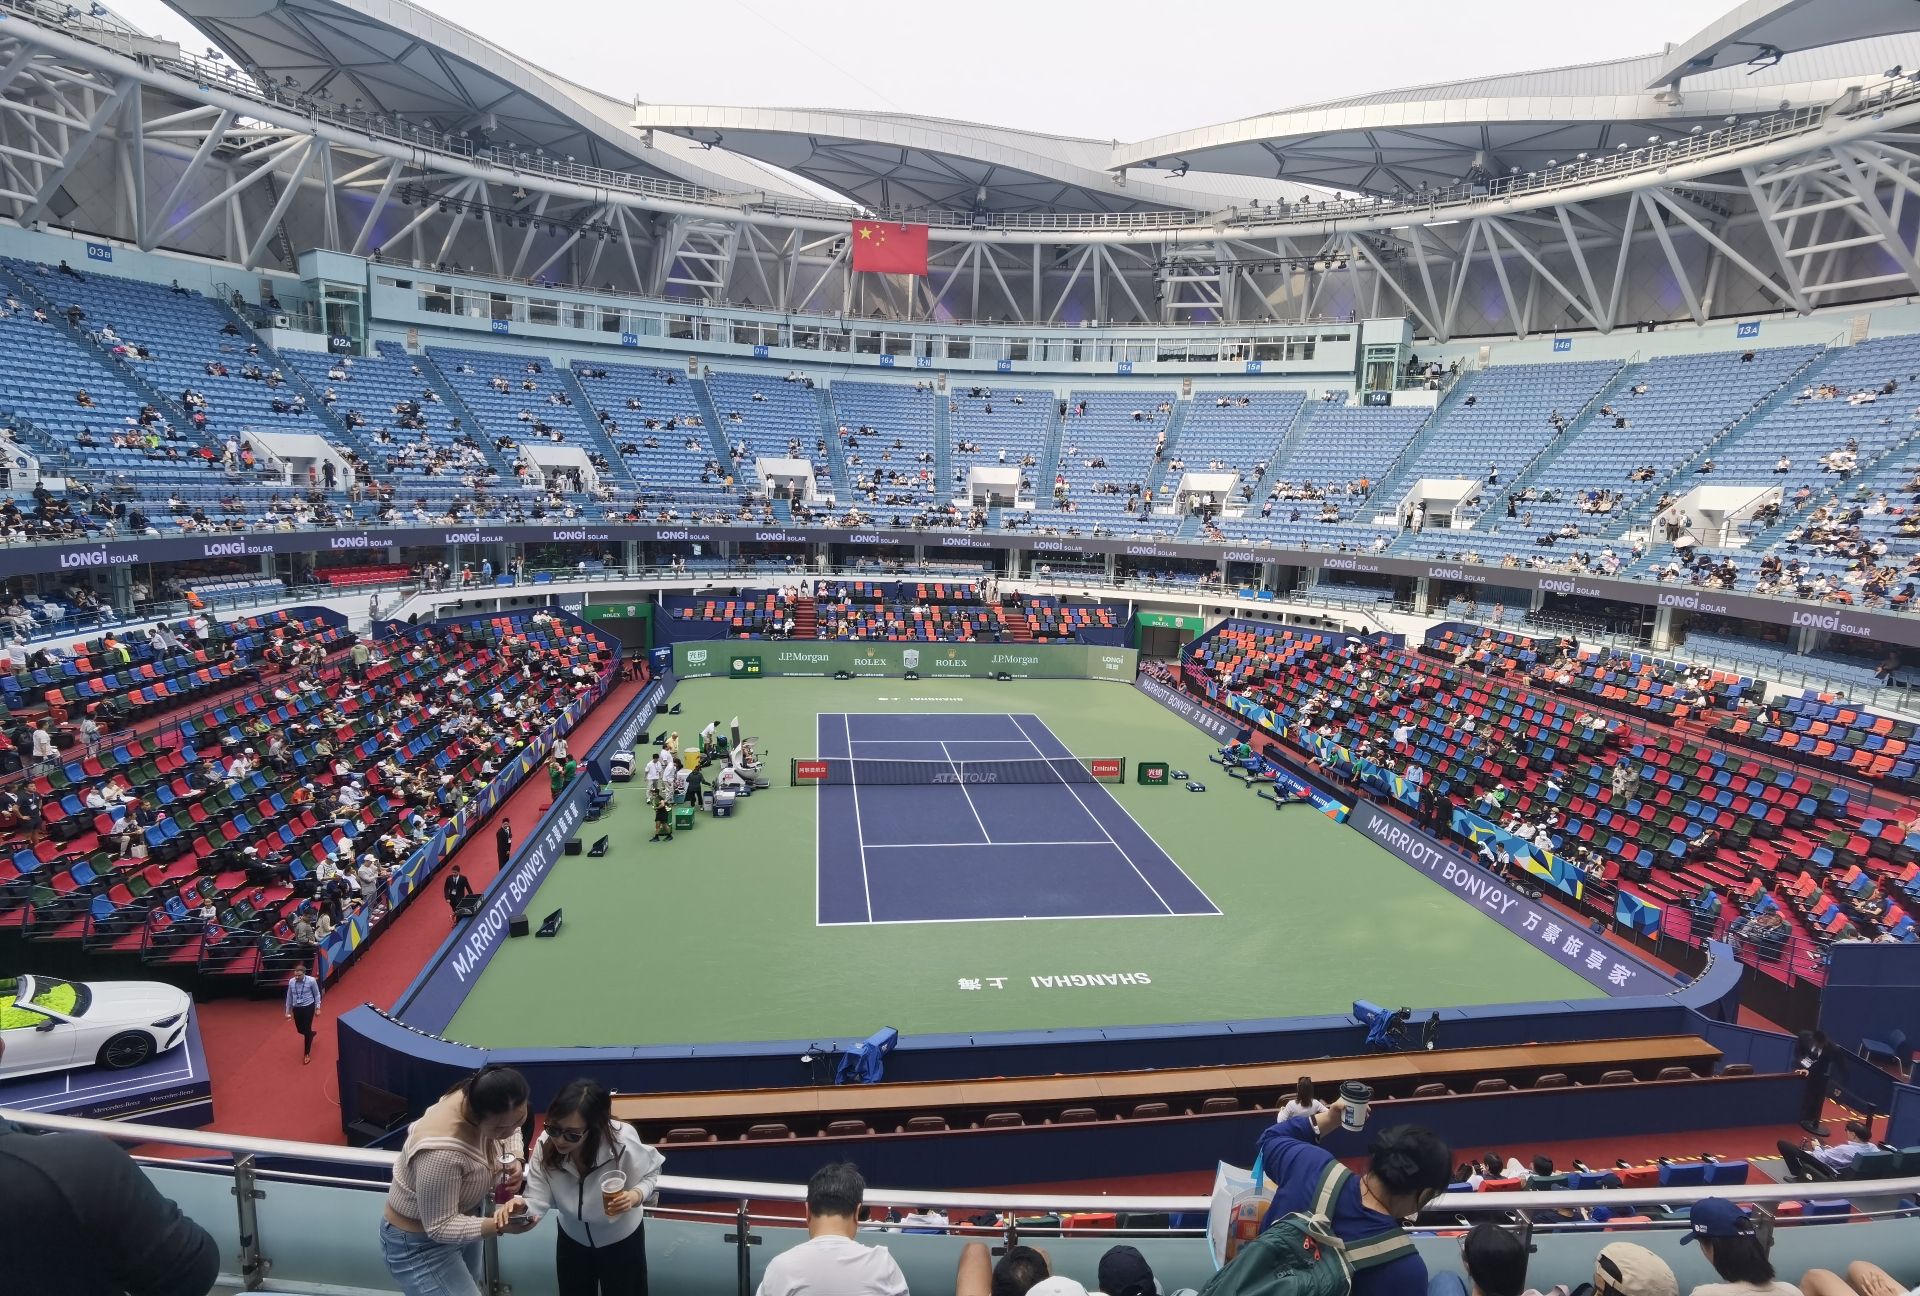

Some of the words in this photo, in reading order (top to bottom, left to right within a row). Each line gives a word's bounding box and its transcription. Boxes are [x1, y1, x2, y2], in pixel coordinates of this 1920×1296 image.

[89, 246, 110, 259] 03B
[492, 322, 508, 331] 02B
[1738, 326, 1758, 335] 13A
[333, 338, 351, 348] 02A
[623, 335, 637, 344] 01A
[1118, 364, 1132, 372] 15A
[1371, 394, 1386, 402] 14A
[370, 539, 393, 547] SOLAR
[248, 545, 273, 554] SOLAR
[110, 554, 138, 564] SOLAR
[1358, 564, 1379, 572] SOLAR
[1464, 574, 1486, 583] SOLAR
[1576, 587, 1600, 597] SOLAR
[1700, 602, 1726, 614] SOLAR
[1840, 623, 1870, 637] SOLAR
[778, 652, 829, 663] J.P.Morgan
[991, 655, 1038, 666] J.P.Morgan
[1142, 679, 1169, 701] MARRIOTT
[963, 773, 997, 782] TOUR
[1367, 814, 1443, 870] MARRIOTT
[1442, 861, 1516, 915] BONVOY
[452, 892, 513, 982] MARRIOTT
[509, 844, 548, 903] BONVOY
[1030, 972, 1151, 988] SHANGHAI
